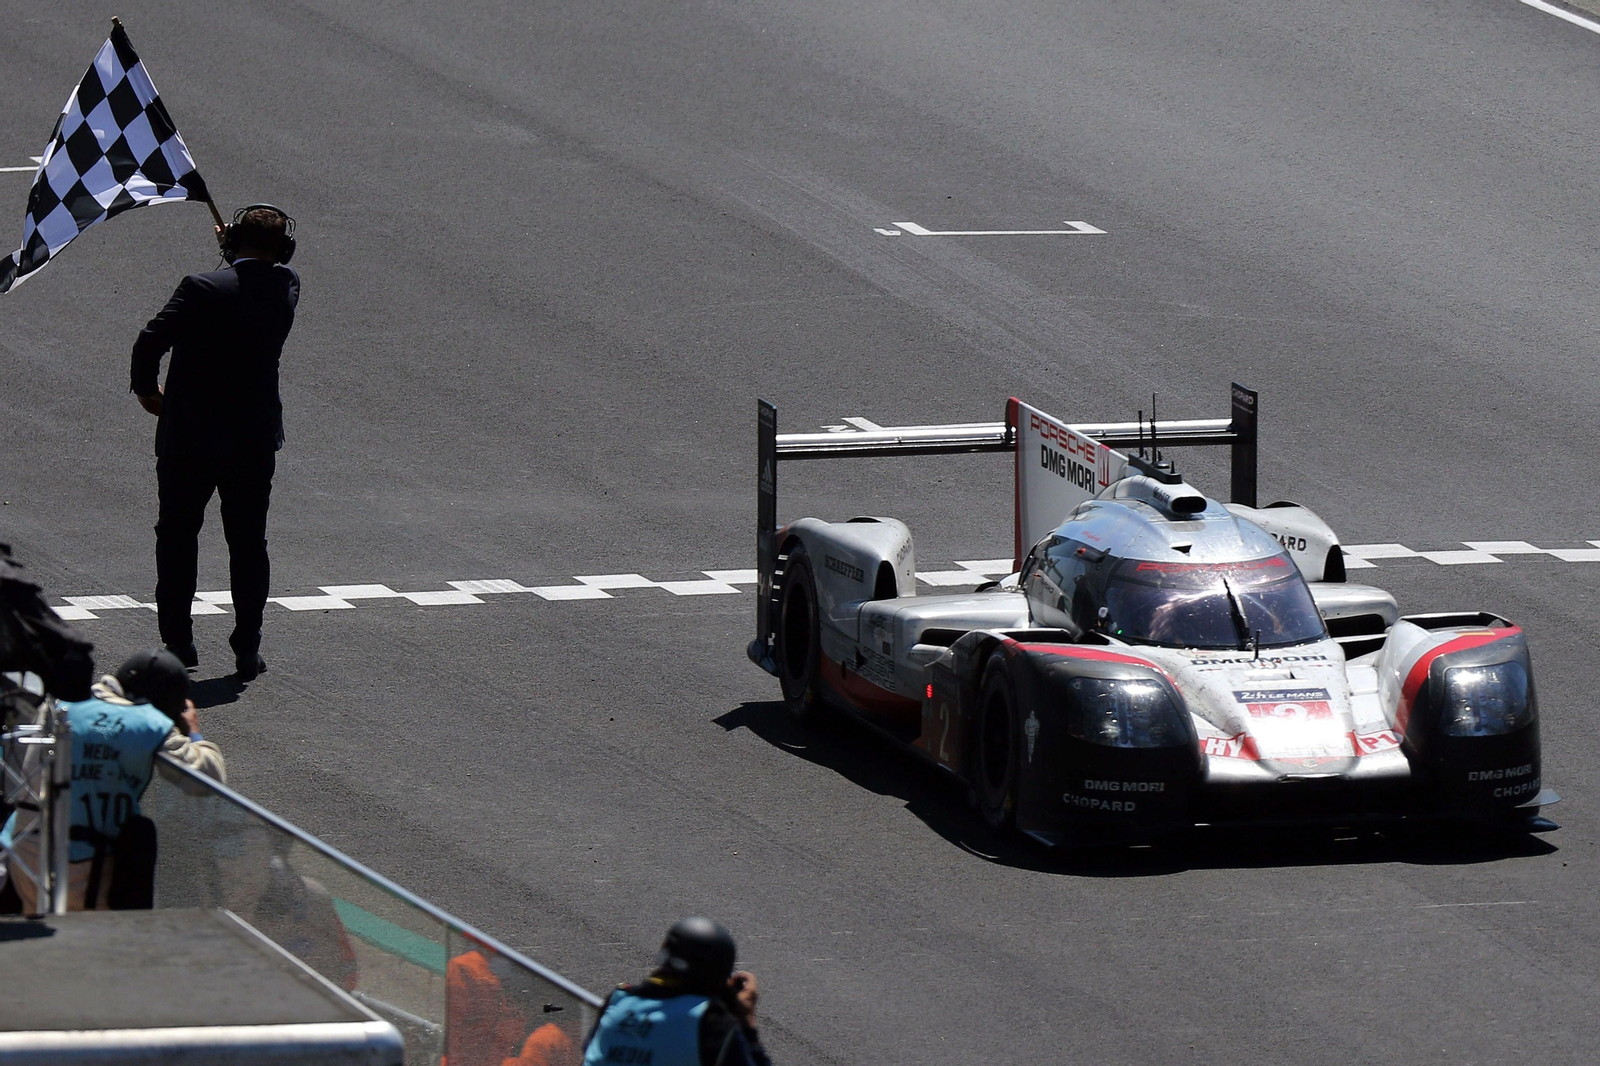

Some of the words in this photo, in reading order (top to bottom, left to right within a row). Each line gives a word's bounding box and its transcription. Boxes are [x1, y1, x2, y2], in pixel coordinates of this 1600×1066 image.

[1031, 413, 1095, 464] PORSCHE
[1041, 444, 1065, 478] DMG
[1067, 458, 1095, 494] MORI
[1136, 556, 1287, 573] PORSCHE
[1190, 657, 1253, 666] DMG
[1253, 655, 1327, 664] MORI
[1204, 732, 1246, 757] HY
[1359, 733, 1399, 750] P1
[1468, 769, 1504, 781] DMG
[1505, 763, 1532, 778] MORI
[1084, 779, 1120, 791] DMG
[1122, 782, 1165, 792] MORI
[1062, 793, 1136, 811] CHOPARD
